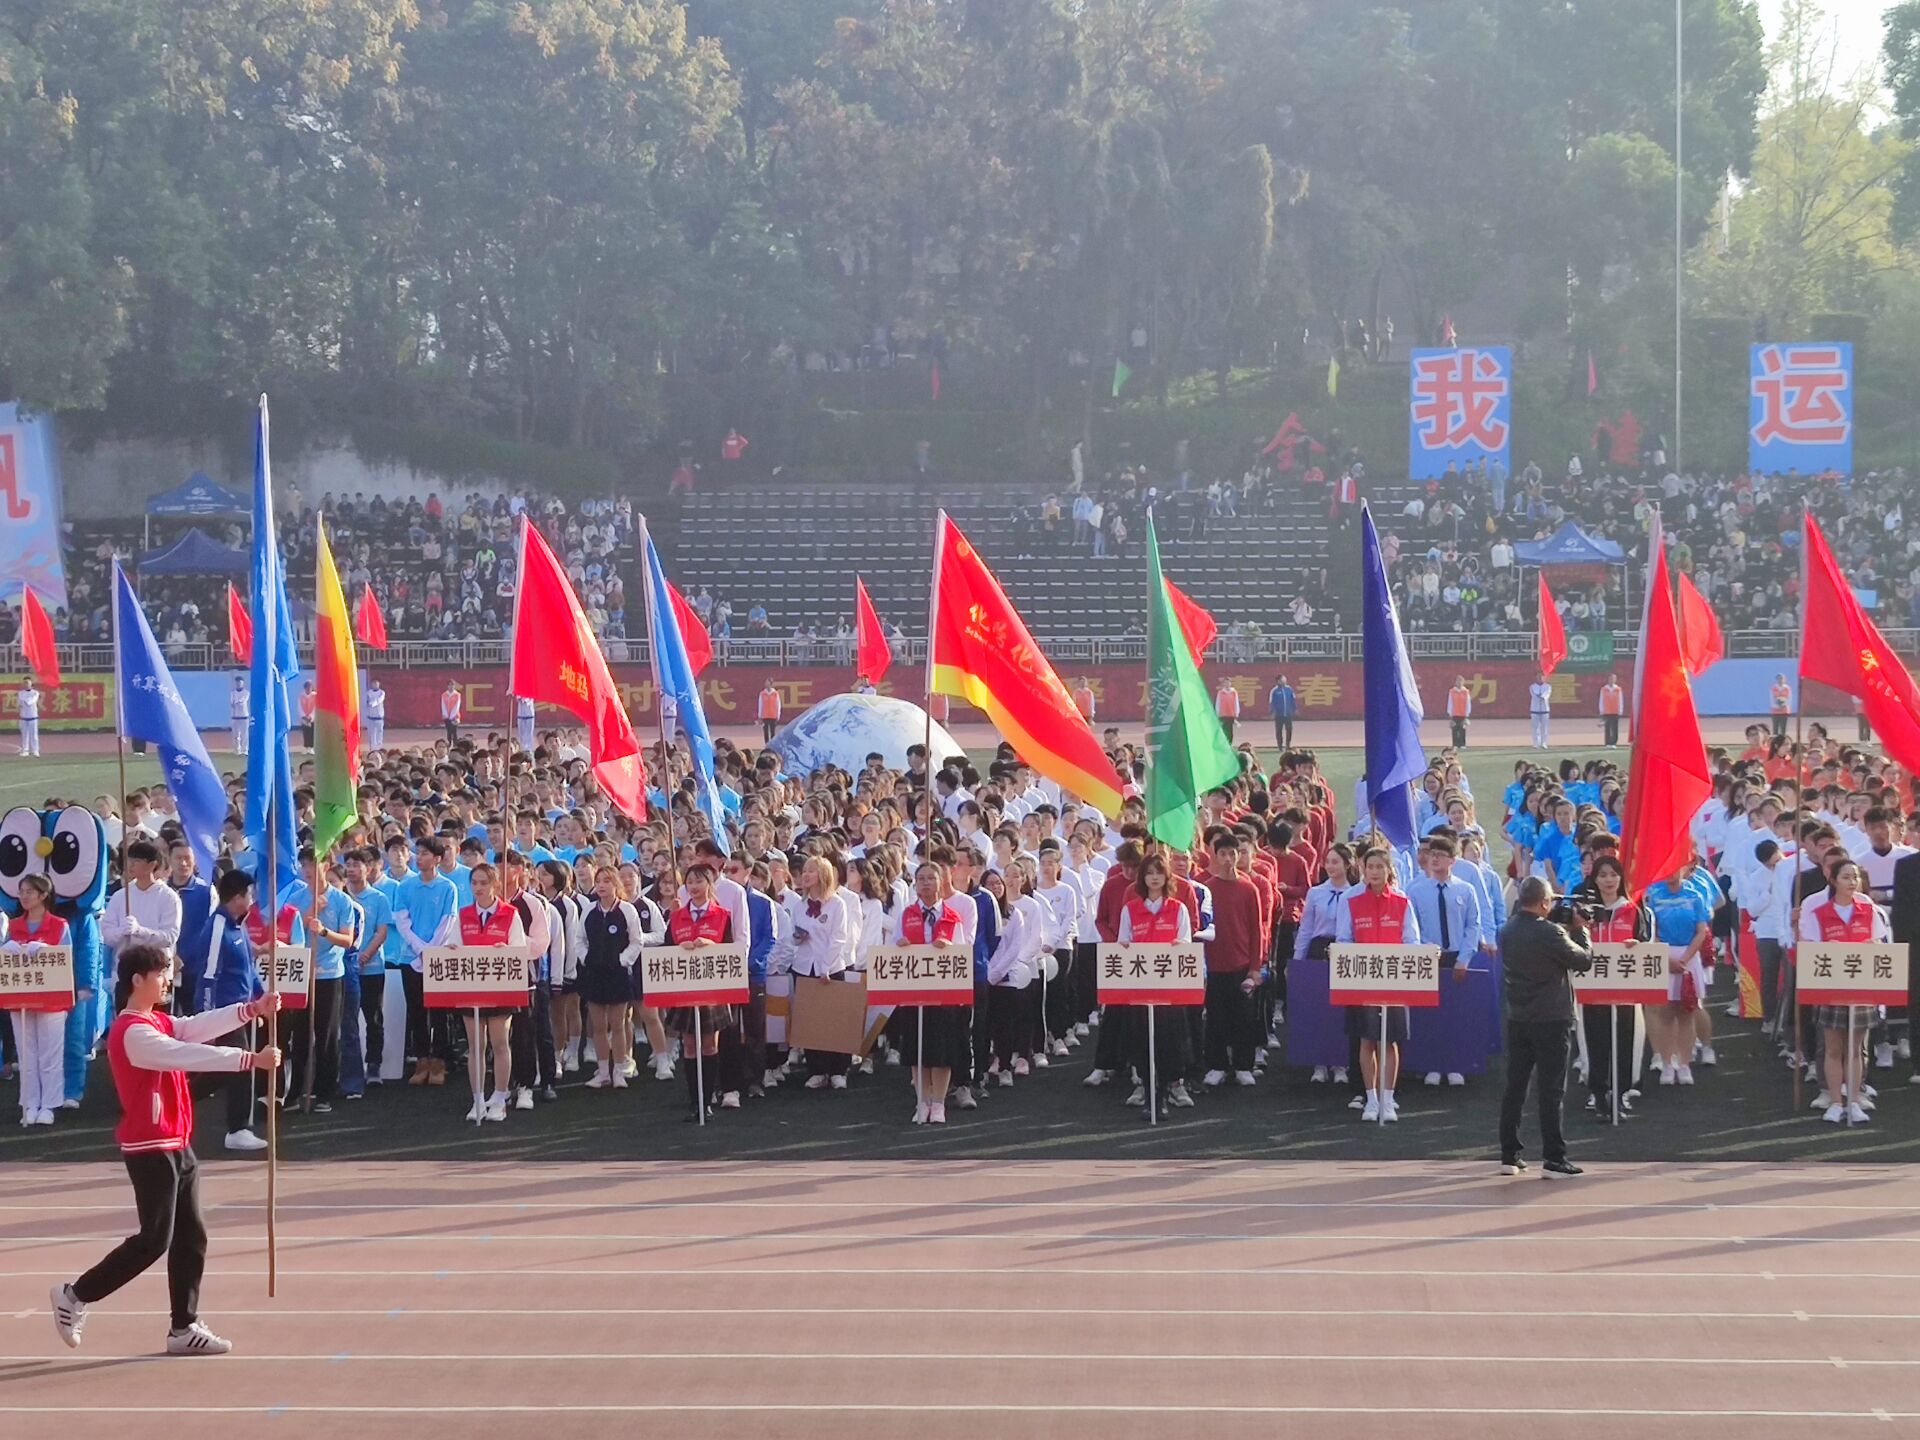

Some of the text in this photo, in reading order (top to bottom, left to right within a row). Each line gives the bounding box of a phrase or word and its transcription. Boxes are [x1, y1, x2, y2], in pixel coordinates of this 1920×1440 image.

[1413, 351, 1507, 448] 我
[1753, 349, 1847, 443] 运
[0, 687, 99, 713] 西茶叶
[0, 952, 66, 968] 与信息科学学院
[254, 957, 304, 982] 学学院
[429, 957, 523, 981] 地理科学学院
[648, 955, 743, 982] 材料与能源学院
[873, 954, 968, 979] 化学化工学院
[1104, 954, 1198, 978] 美术学院
[1336, 954, 1433, 980] 教师教育学院
[1574, 954, 1662, 979] 育学部
[1813, 953, 1893, 979] 法学院
[0, 971, 45, 986] 软件学院
